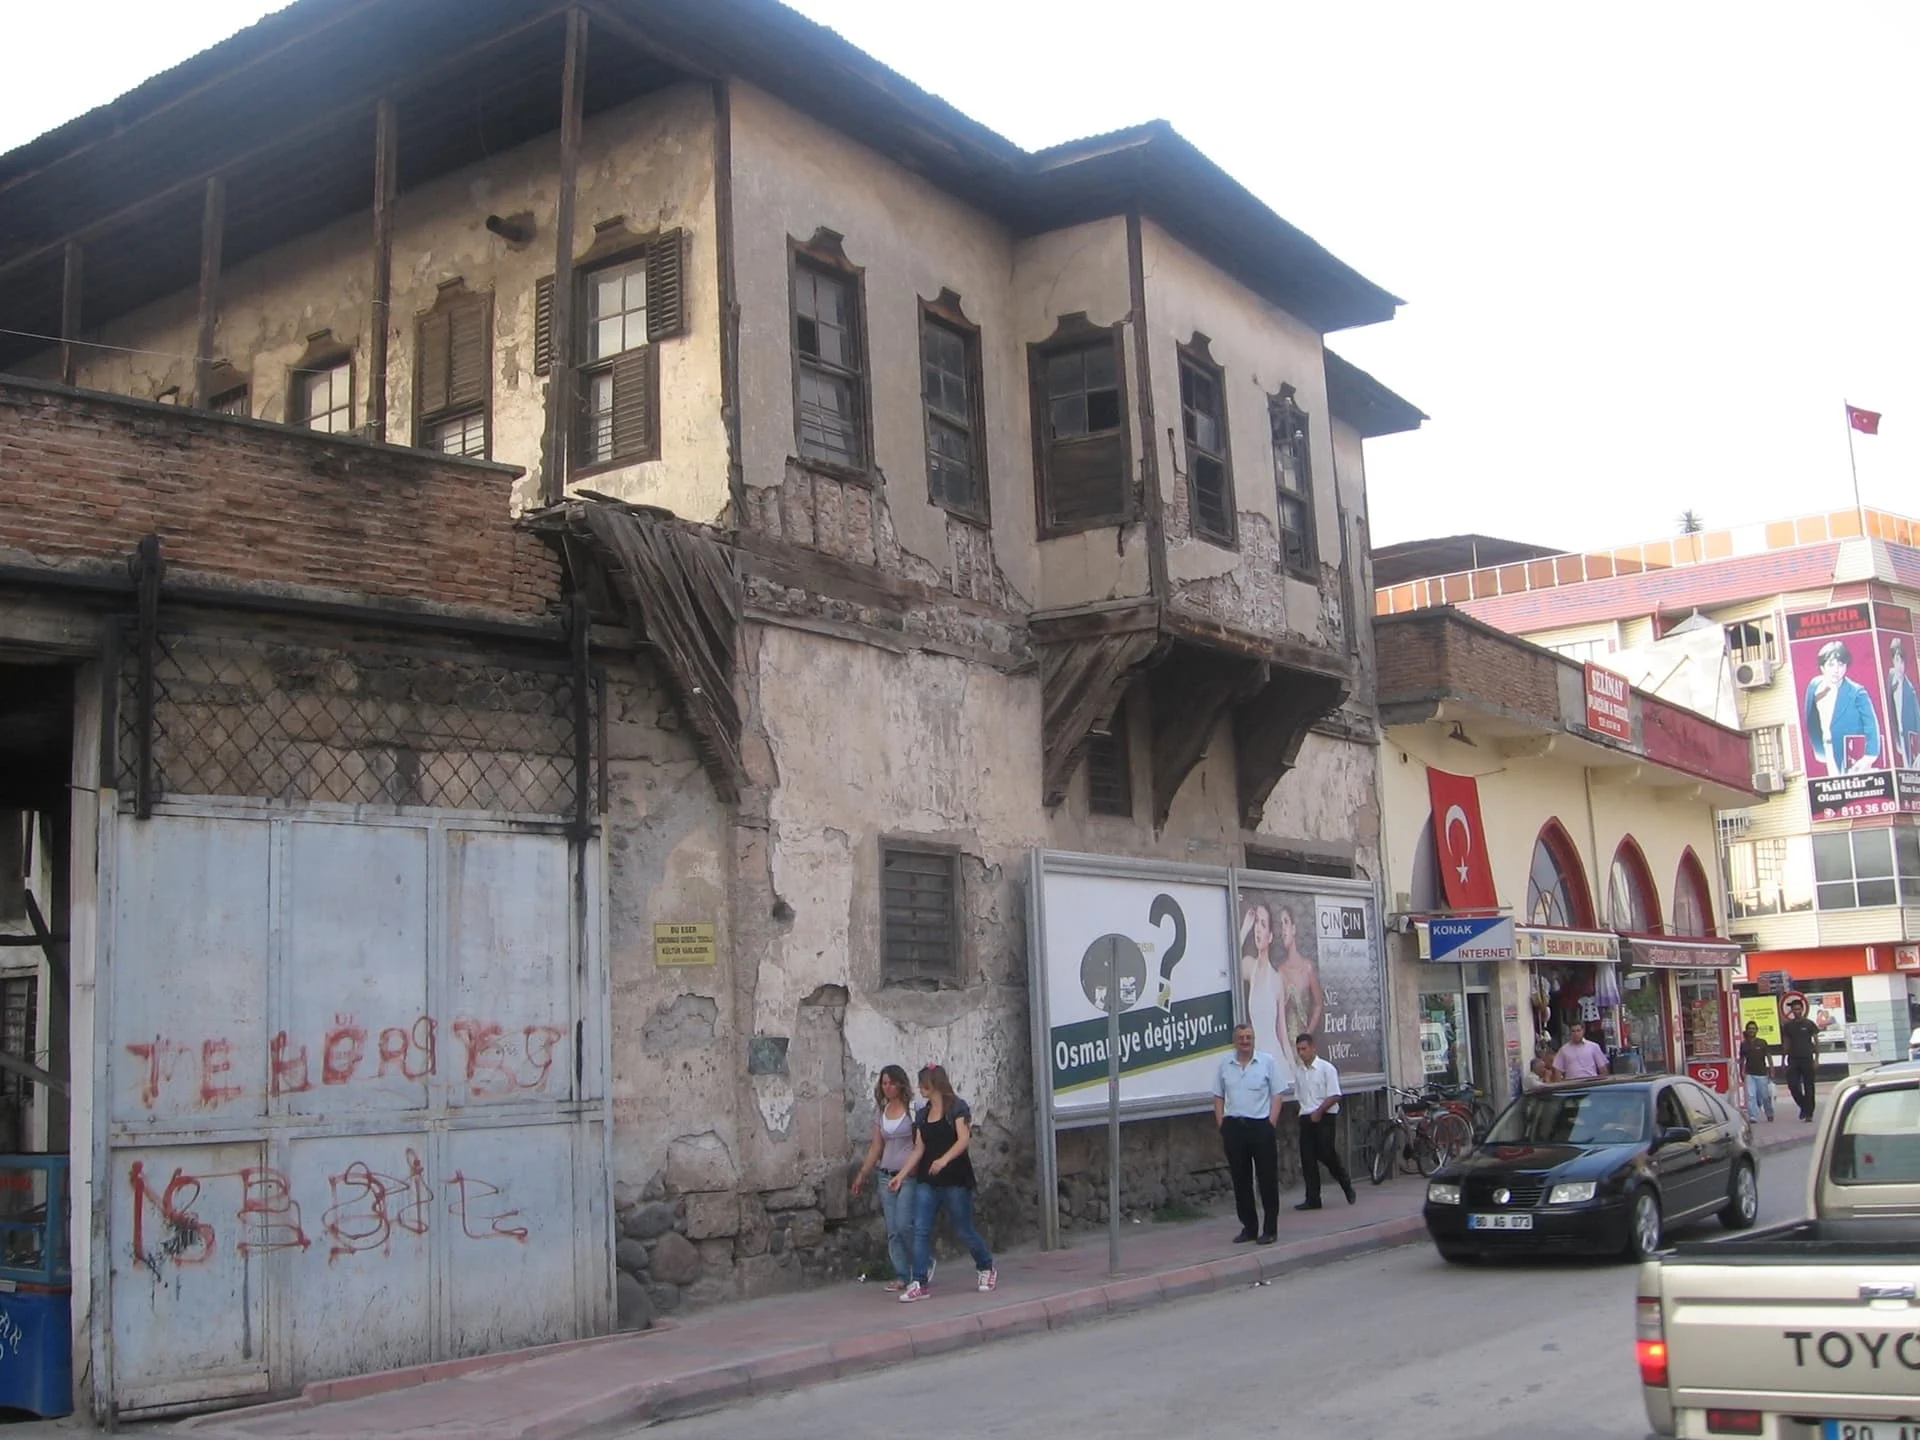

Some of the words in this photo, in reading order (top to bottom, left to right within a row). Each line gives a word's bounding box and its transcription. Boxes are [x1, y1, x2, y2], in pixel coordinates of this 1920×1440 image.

[1800, 608, 1859, 628] KÜLTÜR
[1817, 793, 1842, 802] Olan
[1844, 788, 1885, 800] Kazanır
[1841, 806, 1862, 817] 813
[1864, 803, 1879, 813] 36
[1881, 801, 1895, 811] 00
[1433, 925, 1473, 936] KONAK
[1324, 1013, 1347, 1033] Evet
[1144, 1013, 1227, 1052] değişiyor...
